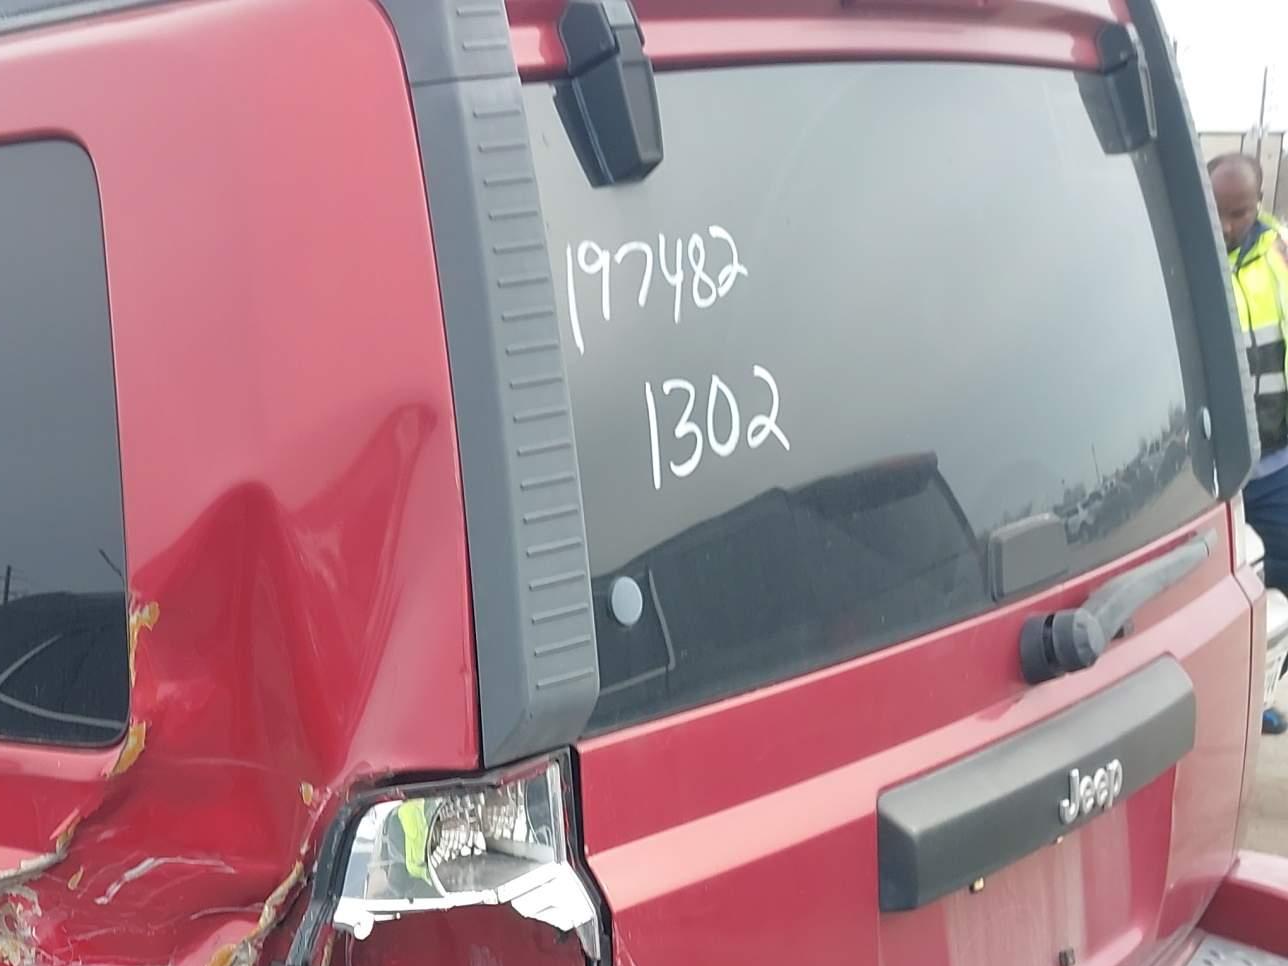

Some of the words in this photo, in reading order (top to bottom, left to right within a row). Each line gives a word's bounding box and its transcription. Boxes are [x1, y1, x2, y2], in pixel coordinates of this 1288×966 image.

[567, 224, 748, 354] 197482
[645, 364, 790, 490] 1302
[1059, 759, 1123, 824] Jeep
